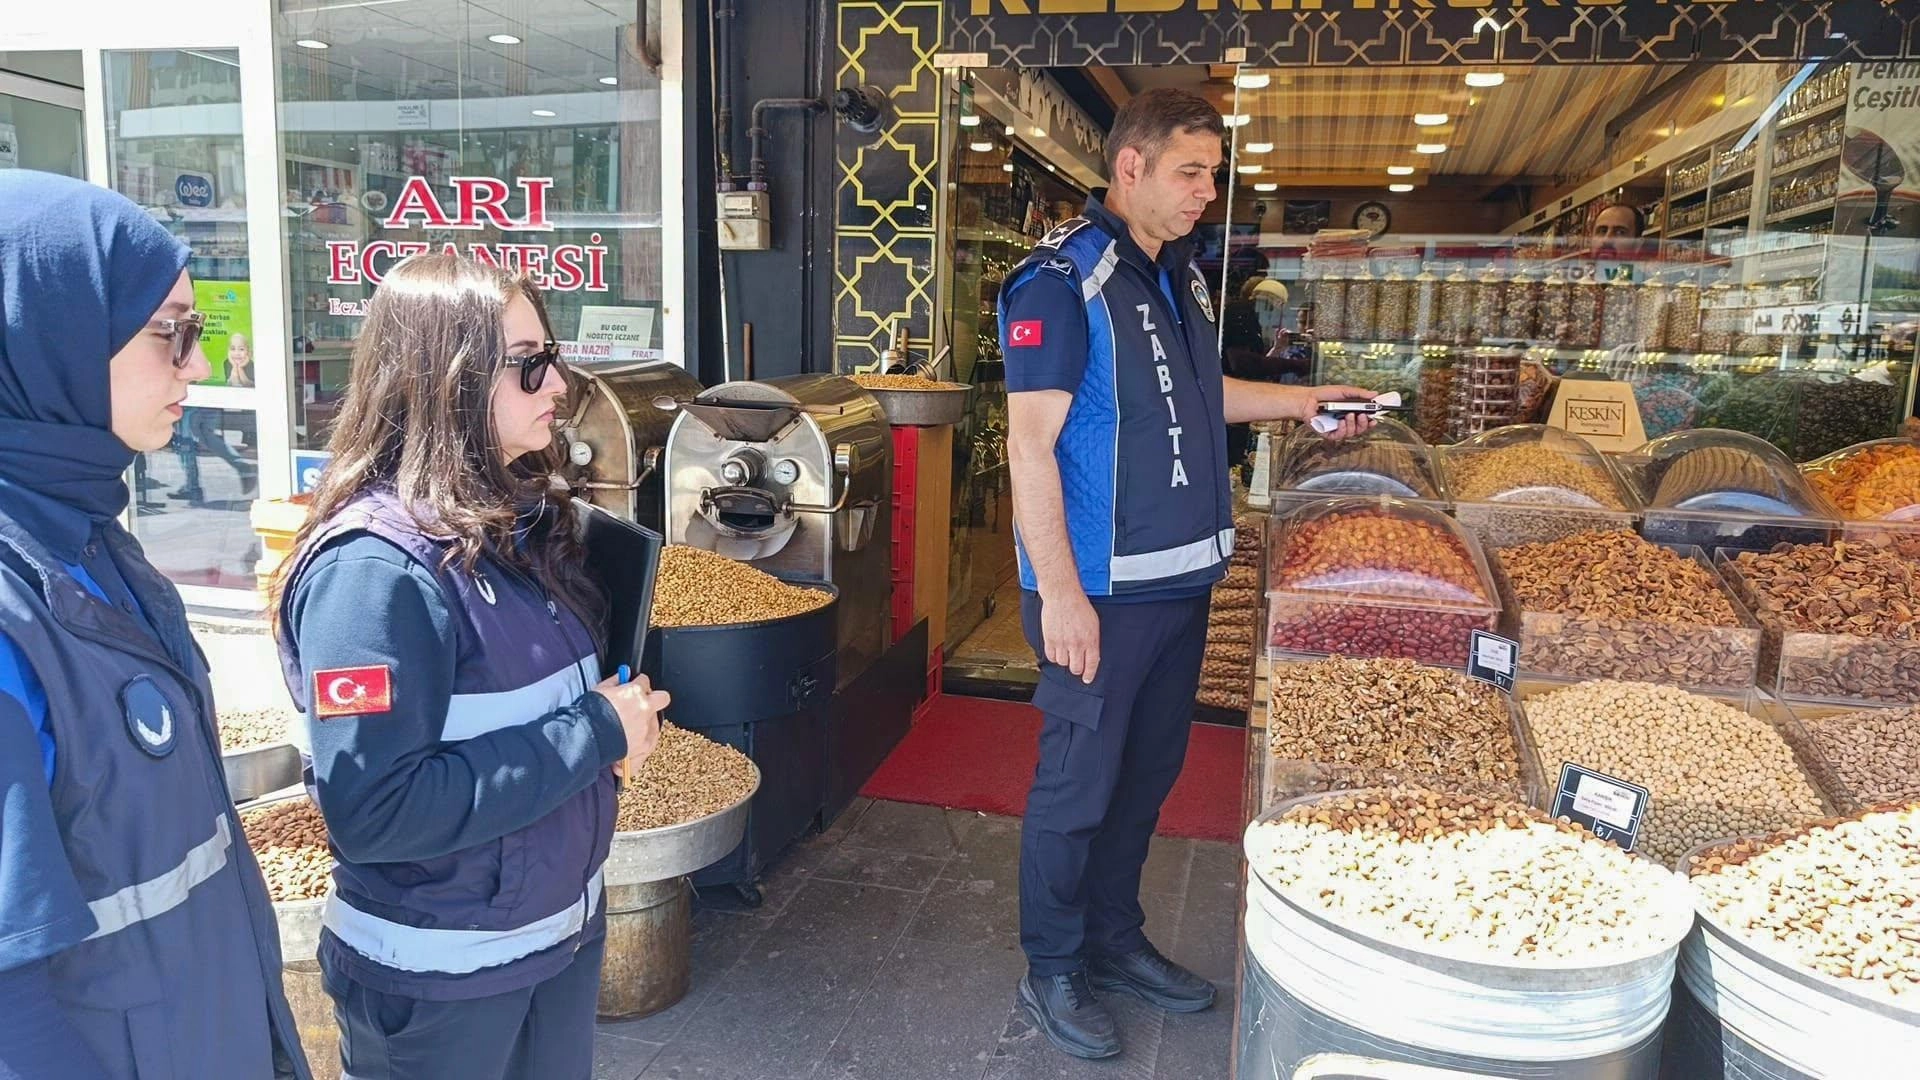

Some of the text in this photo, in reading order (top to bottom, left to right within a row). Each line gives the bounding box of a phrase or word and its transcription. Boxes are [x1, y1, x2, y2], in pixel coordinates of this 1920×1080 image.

[1856, 62, 1920, 79] Pekm
[1854, 86, 1920, 111] Çeşitl
[385, 176, 554, 231] ARI
[1136, 304, 1189, 487] ZABITA
[1569, 406, 1622, 421] KESKİN
